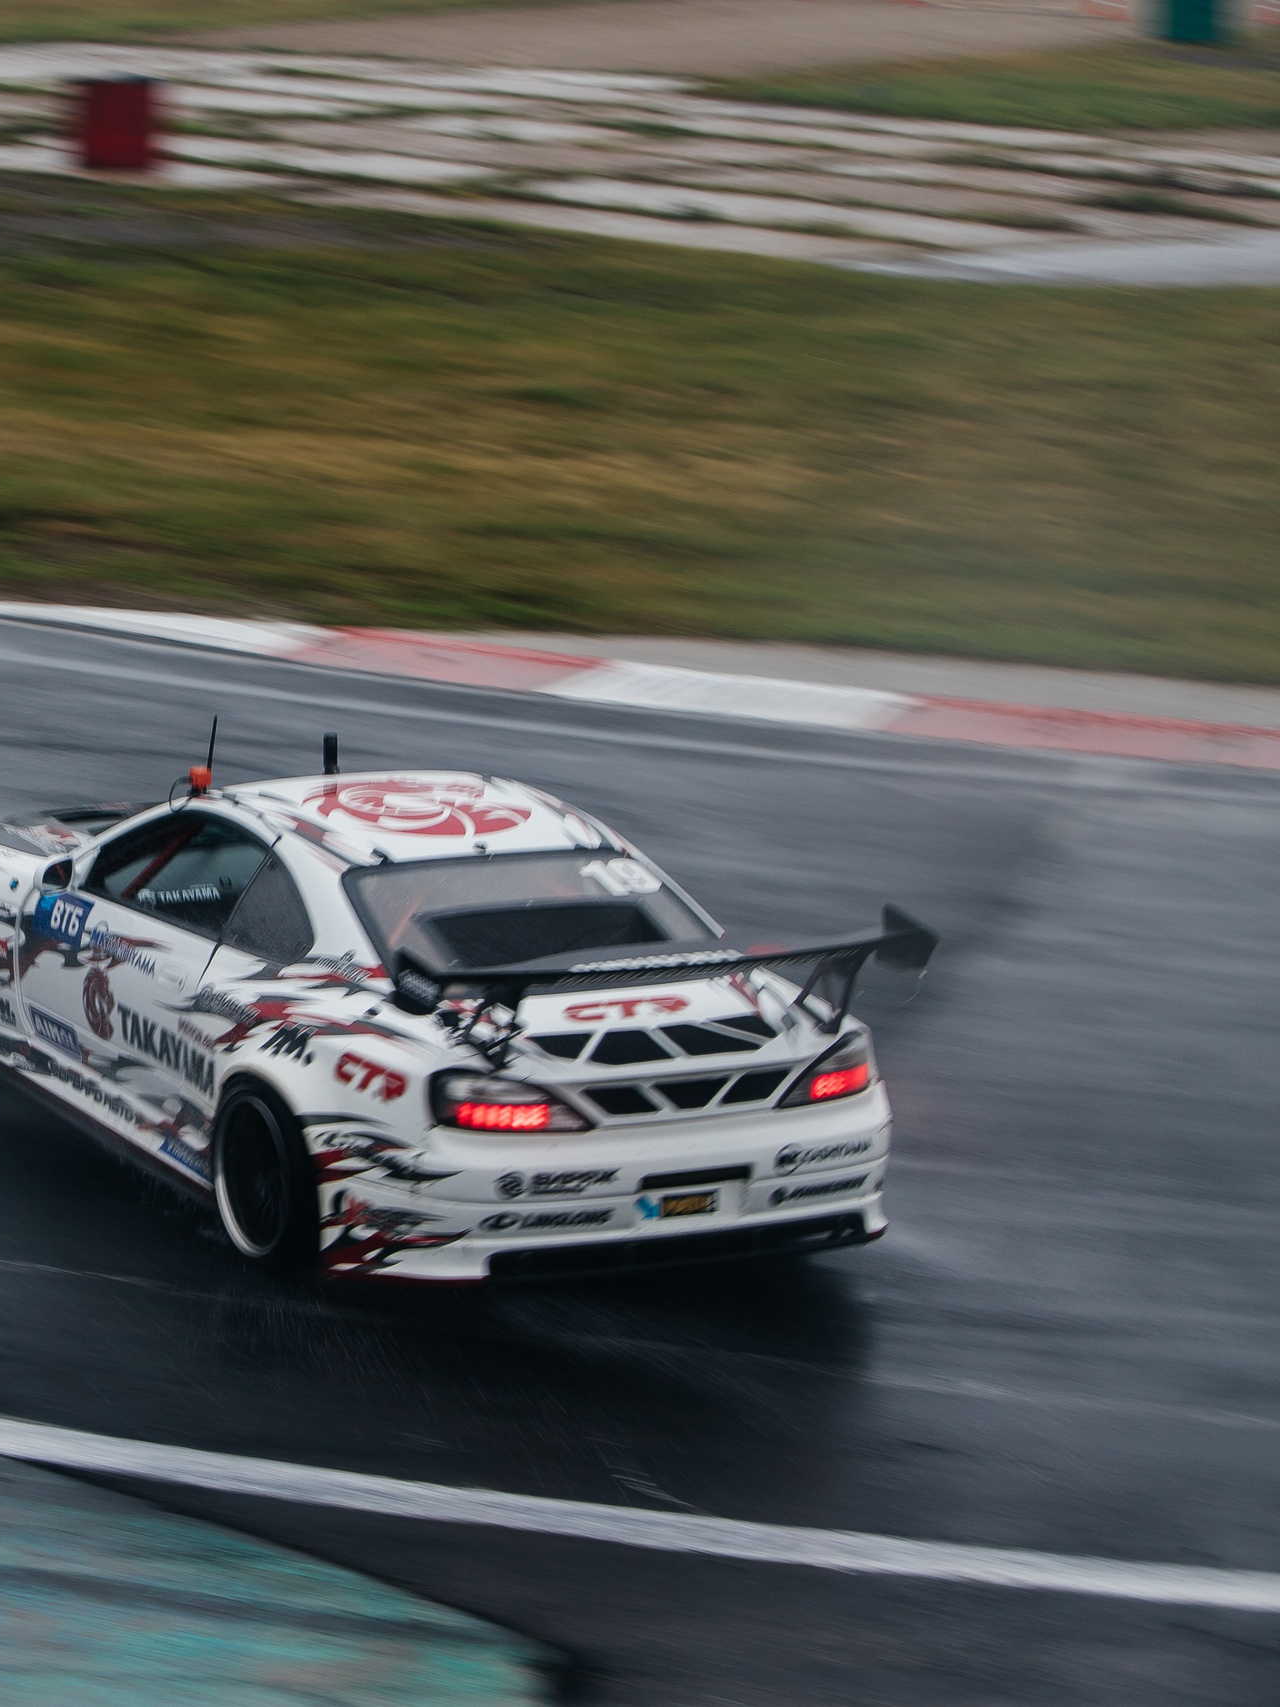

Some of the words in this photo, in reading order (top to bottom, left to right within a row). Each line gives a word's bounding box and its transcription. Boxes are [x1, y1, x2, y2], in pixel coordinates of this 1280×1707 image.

[157, 886, 221, 905] TAKAYAMA
[578, 857, 663, 897] 19
[50, 898, 84, 937] ВТБ
[117, 1000, 215, 1100] TAKAYAMA
